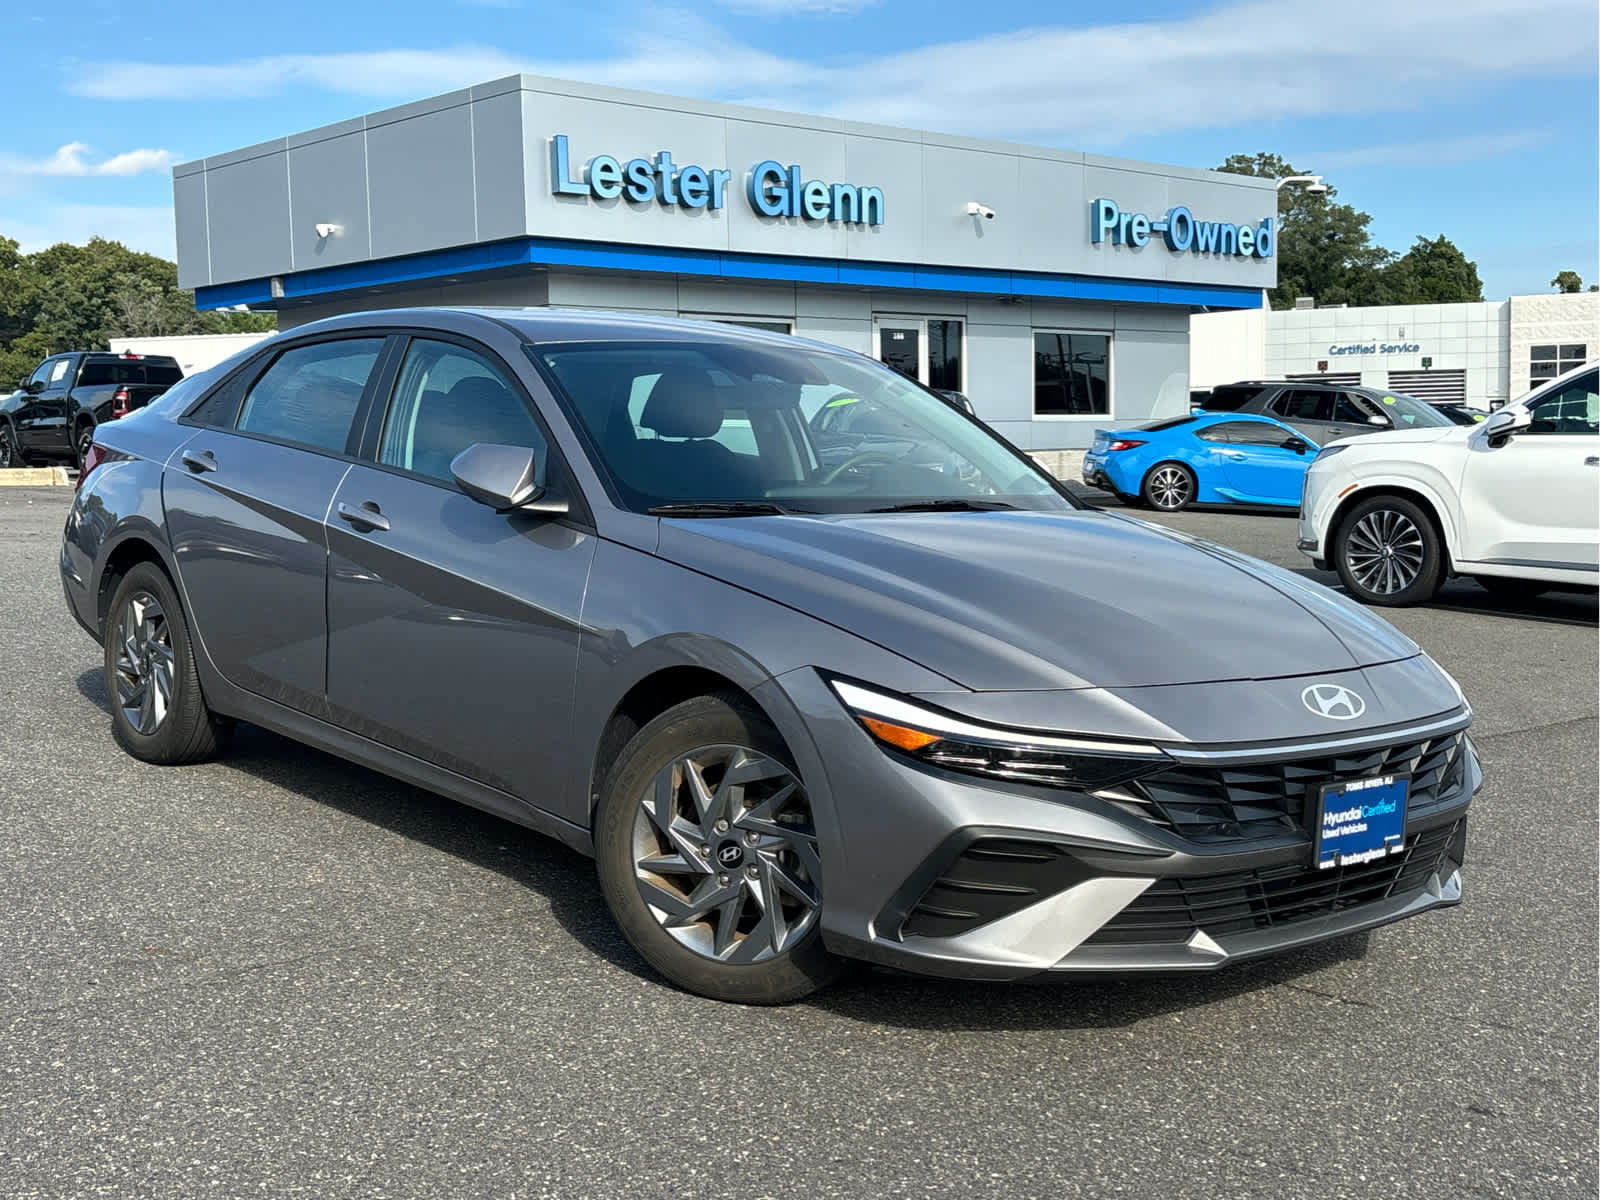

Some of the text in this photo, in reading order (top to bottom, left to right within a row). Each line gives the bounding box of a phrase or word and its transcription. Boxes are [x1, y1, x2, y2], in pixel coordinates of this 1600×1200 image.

[551, 134, 885, 226] Lester Glenn
[1091, 198, 1274, 259] Pre-Owned
[1328, 342, 1420, 356] Certified Service
[1340, 822, 1367, 835] Vehicles
